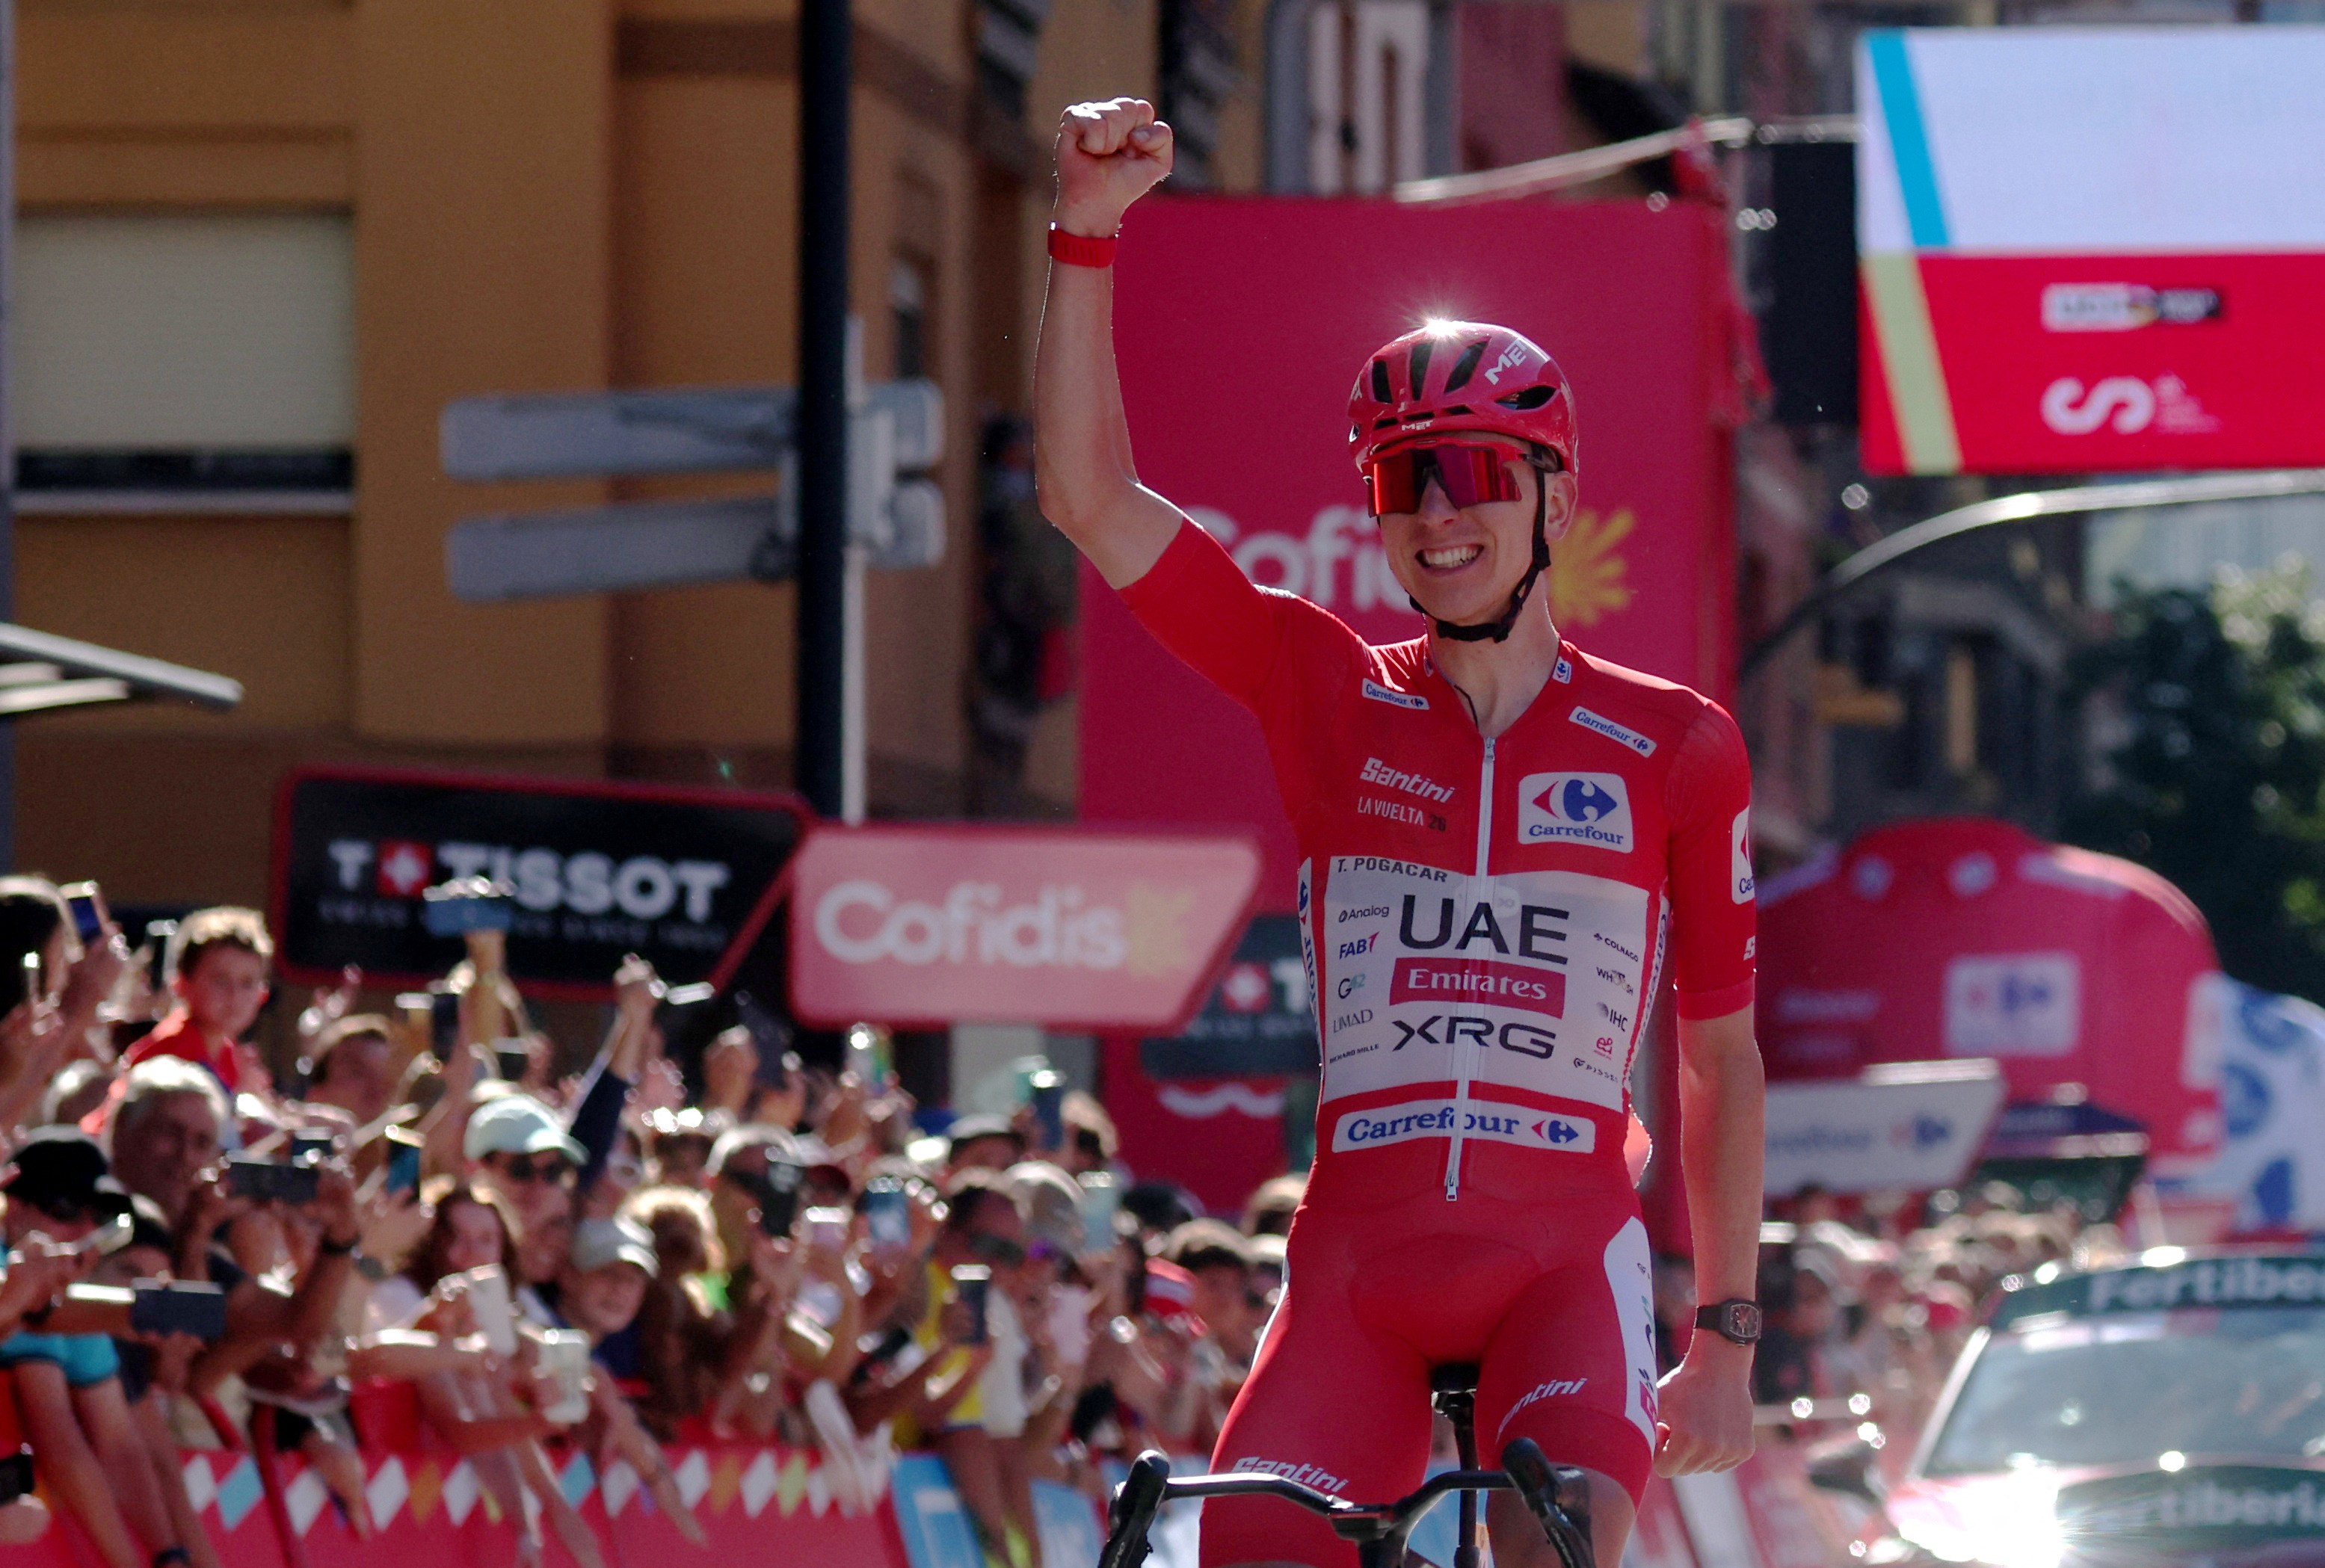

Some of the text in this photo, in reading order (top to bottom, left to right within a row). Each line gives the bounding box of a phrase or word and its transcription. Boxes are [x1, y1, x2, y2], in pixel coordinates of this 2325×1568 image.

[1485, 337, 1527, 385] MET
[1401, 419, 1433, 431] MET
[1366, 683, 1408, 706] Carrefour
[1576, 711, 1630, 742] Carrefour
[1359, 757, 1456, 803] Santini
[1374, 800, 1424, 827] VUELTA
[1529, 824, 1624, 845] Carrefour
[1337, 857, 1449, 883] T. POGACAR
[815, 878, 1127, 969] Cofidis
[1348, 905, 1390, 921] Analog
[1399, 895, 1569, 965] UAE
[1604, 937, 1639, 963] COLNAGO
[1408, 969, 1547, 1000] Emirates
[1609, 1009, 1628, 1032] IHC
[1391, 1016, 1556, 1060] XRG
[1348, 1107, 1519, 1142] Carrefour
